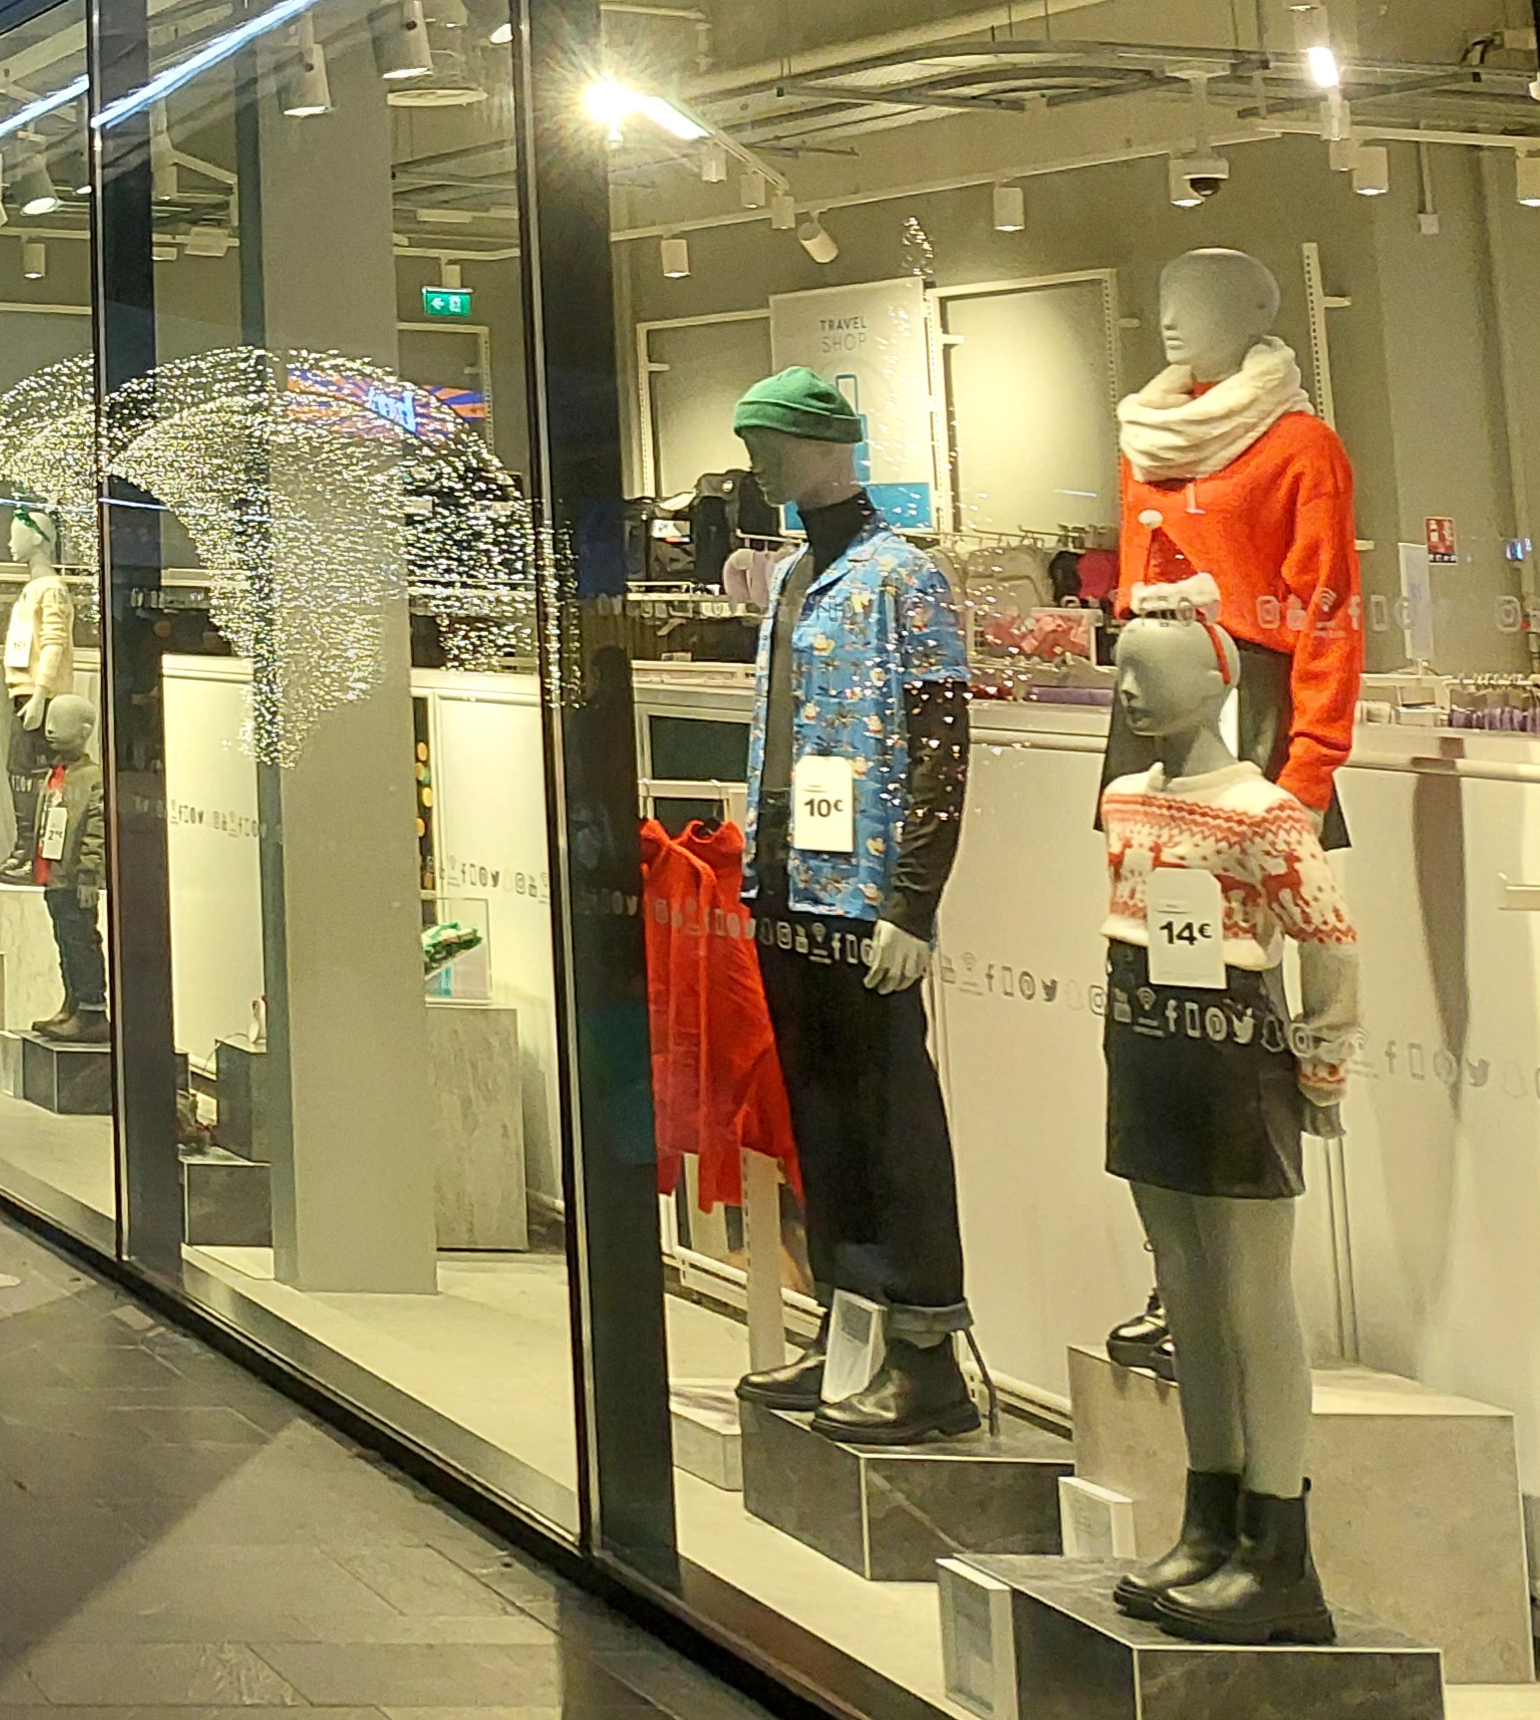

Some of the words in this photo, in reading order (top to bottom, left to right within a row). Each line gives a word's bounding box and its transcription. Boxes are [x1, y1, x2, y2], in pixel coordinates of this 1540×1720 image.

[820, 316, 867, 332] TRAVEL
[822, 332, 867, 354] SHOP
[804, 798, 844, 818] 10€
[1159, 920, 1213, 946] 14€
